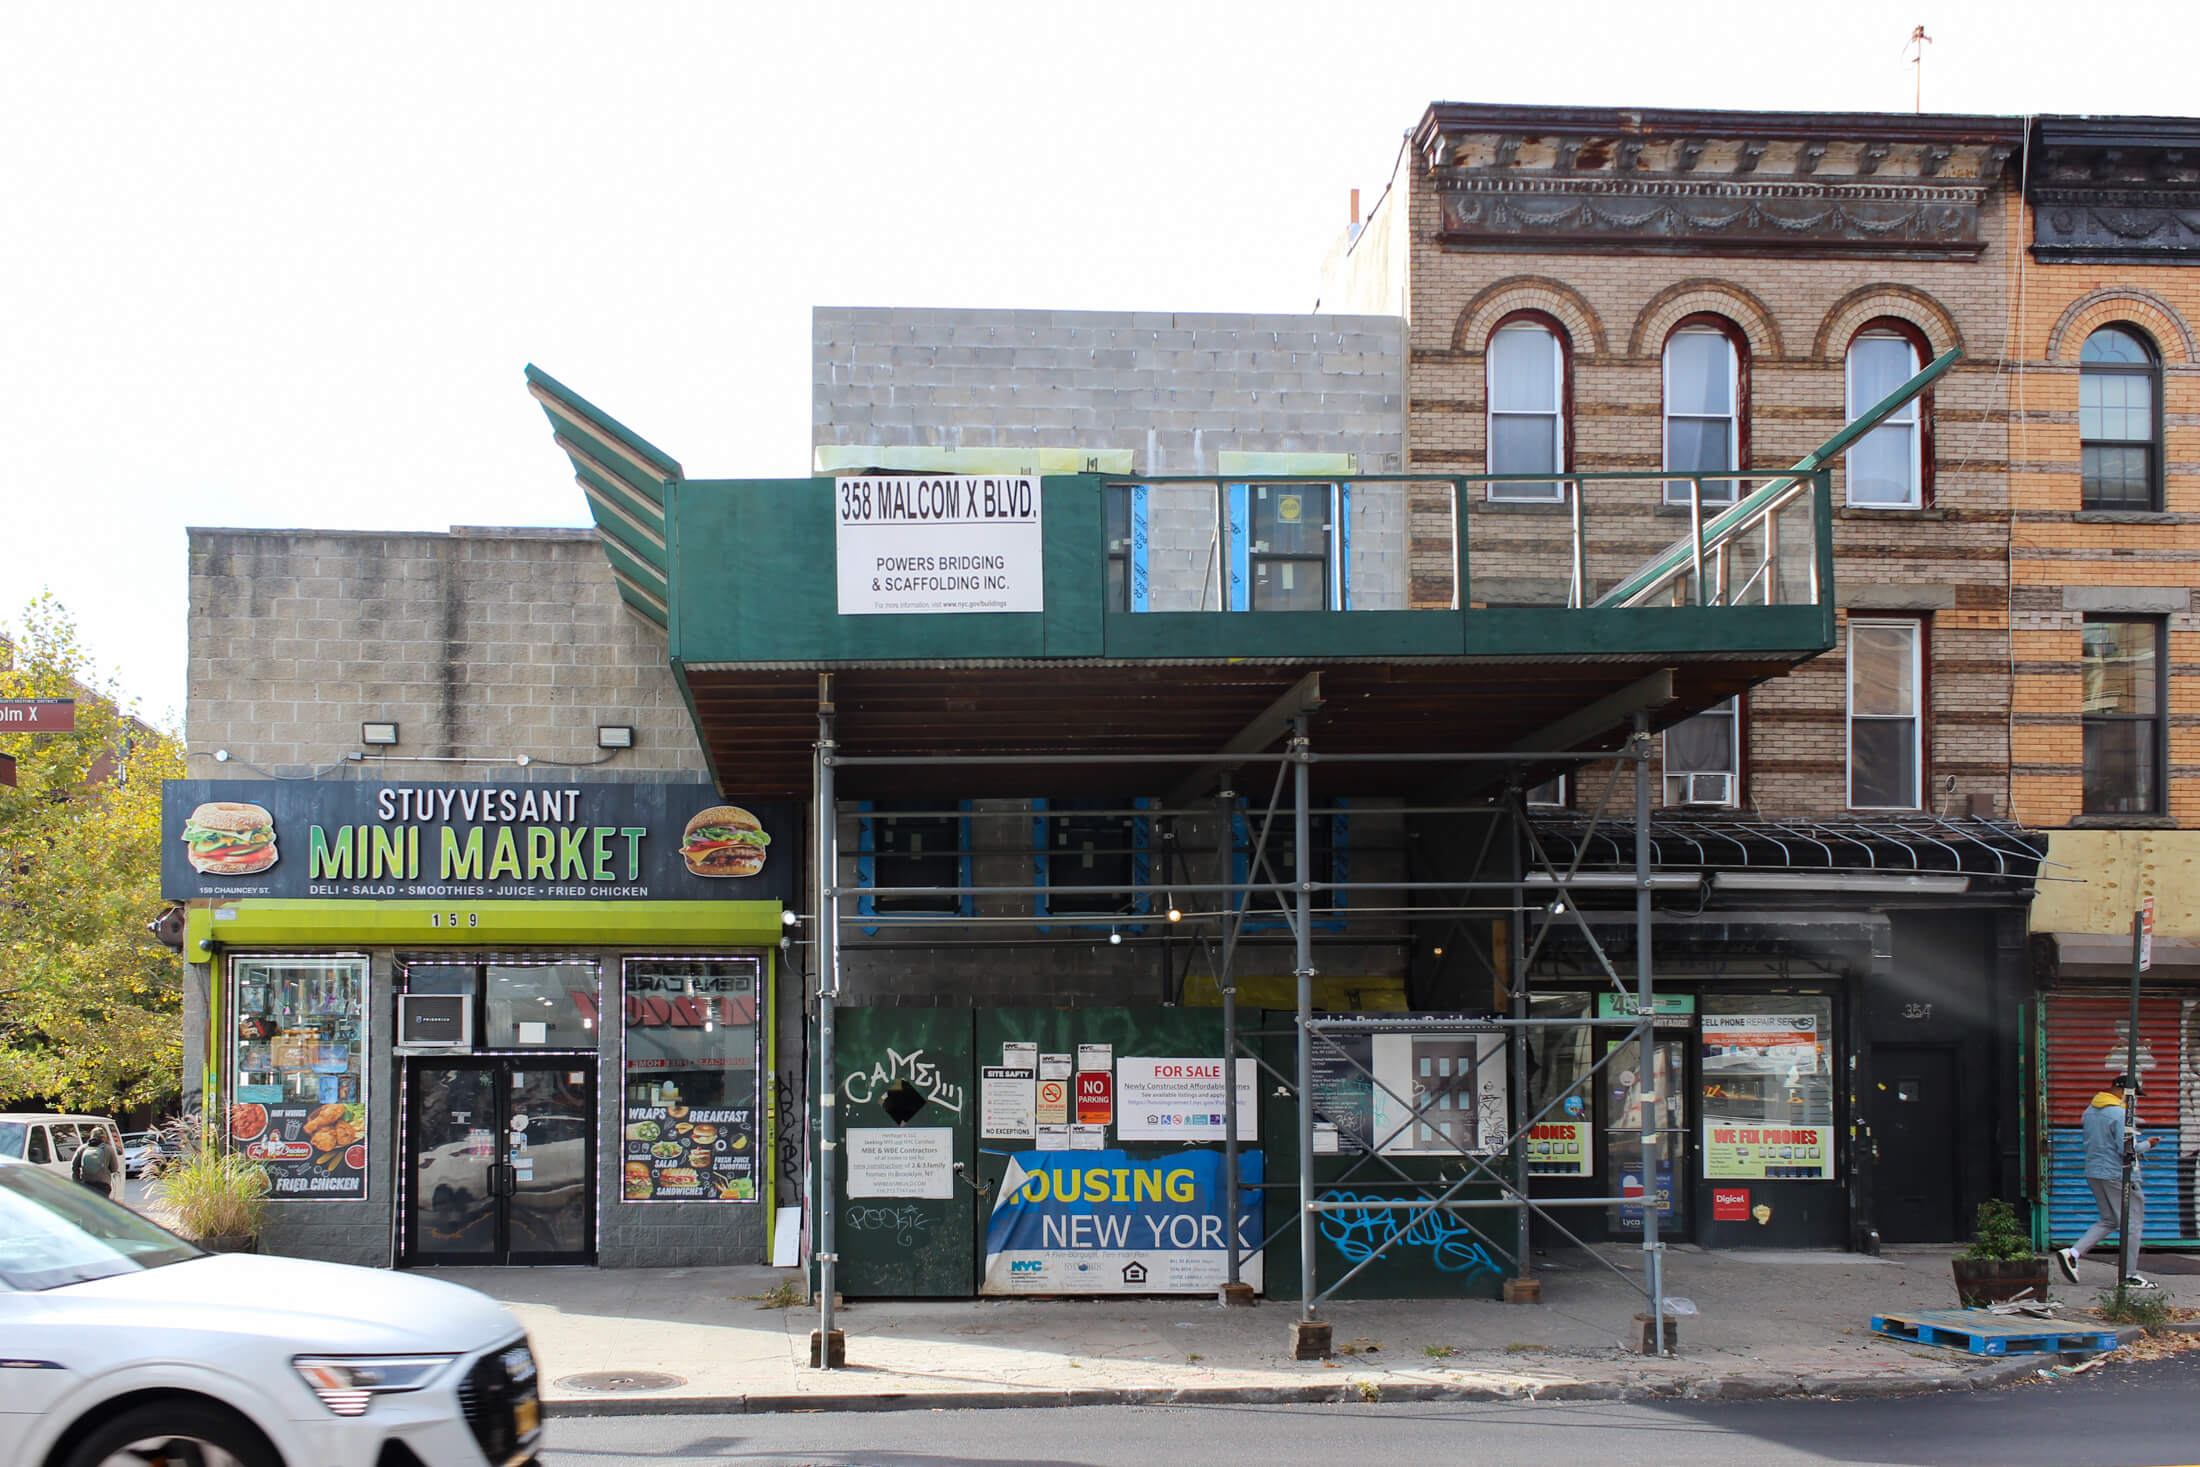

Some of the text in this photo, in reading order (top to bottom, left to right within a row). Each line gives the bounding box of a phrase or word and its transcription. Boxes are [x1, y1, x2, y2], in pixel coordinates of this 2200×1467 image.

[842, 479, 1037, 520] 358 MALCOM X BLVD.
[876, 555, 1005, 571] POWERS BRIDGING
[872, 575, 1010, 592] & SCAFFOLDING INC.
[28, 706, 38, 721] X
[378, 788, 581, 823] STUYVESANT
[309, 824, 647, 882] MINI MARKET
[309, 884, 649, 897] DELI SALAD SMOOTHIES JUICE FRIED CHICKEN
[1720, 1018, 1745, 1026] PHONE
[1746, 1017, 1775, 1026] REPAIR
[1154, 1065, 1221, 1077] FOR SALE
[1083, 1080, 1104, 1094] NO
[1124, 1083, 1145, 1091] Newly
[1147, 1082, 1188, 1090] Constructed
[1190, 1082, 1225, 1090] Affordable
[1078, 1095, 1109, 1103] PARKING
[628, 1108, 749, 1123] WRAPS BREAKFAST
[1530, 1125, 1576, 1140] HONES
[1714, 1129, 1818, 1145] WE FIX PHONES
[654, 1160, 678, 1168] SALAD
[276, 1177, 359, 1192] FRIED CHICKEN
[656, 1187, 704, 1196] SANDWICHES
[1009, 1169, 1195, 1205] OUSING
[1716, 1194, 1744, 1204] Digicel
[1622, 1218, 1641, 1226] Lyca
[1042, 1214, 1251, 1248] NEW YORK
[1011, 1261, 1042, 1271] NYC
